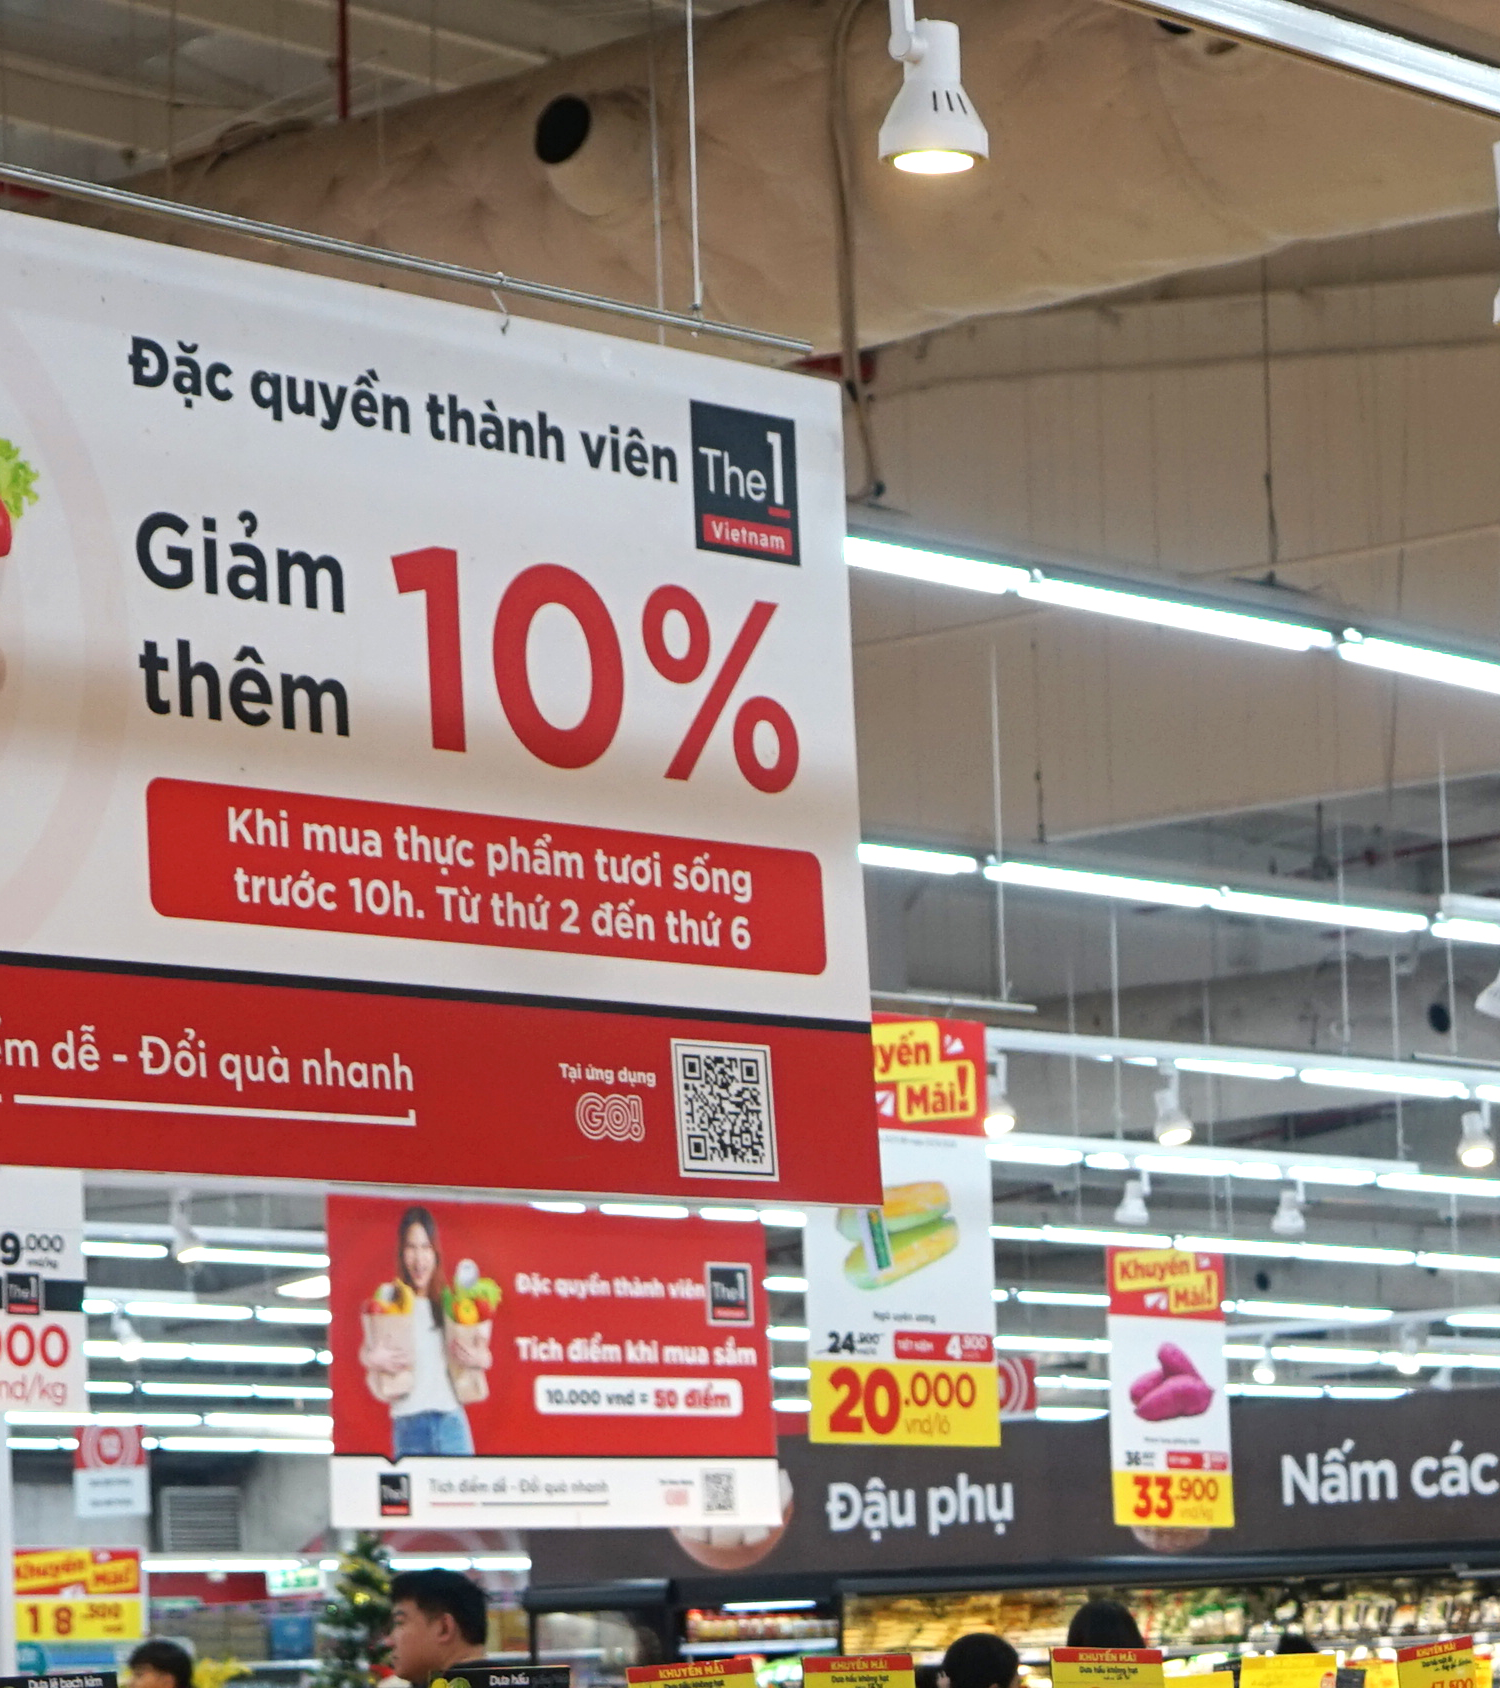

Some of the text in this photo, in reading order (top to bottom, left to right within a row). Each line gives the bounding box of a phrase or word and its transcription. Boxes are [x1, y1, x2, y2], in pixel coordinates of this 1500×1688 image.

[128, 335, 678, 483] Đặc quyền thành viên
[135, 511, 345, 614] Giảm
[710, 518, 787, 551] Vietnam
[139, 638, 350, 737] thêm
[390, 546, 799, 793] 10%
[227, 806, 752, 903] Khi mua thực phẩm tươi sống
[234, 867, 751, 949] trước 10h. Từ thứ 2 đến thứ 6
[53, 1023, 100, 1073] dễ
[139, 1026, 208, 1079] Đổi
[219, 1036, 289, 1089] quà
[302, 1049, 414, 1093] nhanh
[558, 1062, 657, 1088] Tại ứng dụng
[906, 1064, 970, 1114] Mãi!
[575, 1092, 646, 1142] GO!
[614, 1275, 664, 1298] thành
[668, 1277, 705, 1299] viên
[516, 1333, 756, 1366] Tích điểm khi mua sắm
[654, 1389, 676, 1408] 50
[829, 1367, 977, 1434] 20.000
[1133, 1475, 1219, 1518] 33.900
[1281, 1439, 1397, 1506] Nấm
[1410, 1439, 1499, 1499] các
[826, 1473, 1014, 1543] Đậu phụ
[658, 1661, 703, 1679] KHUYẾN
